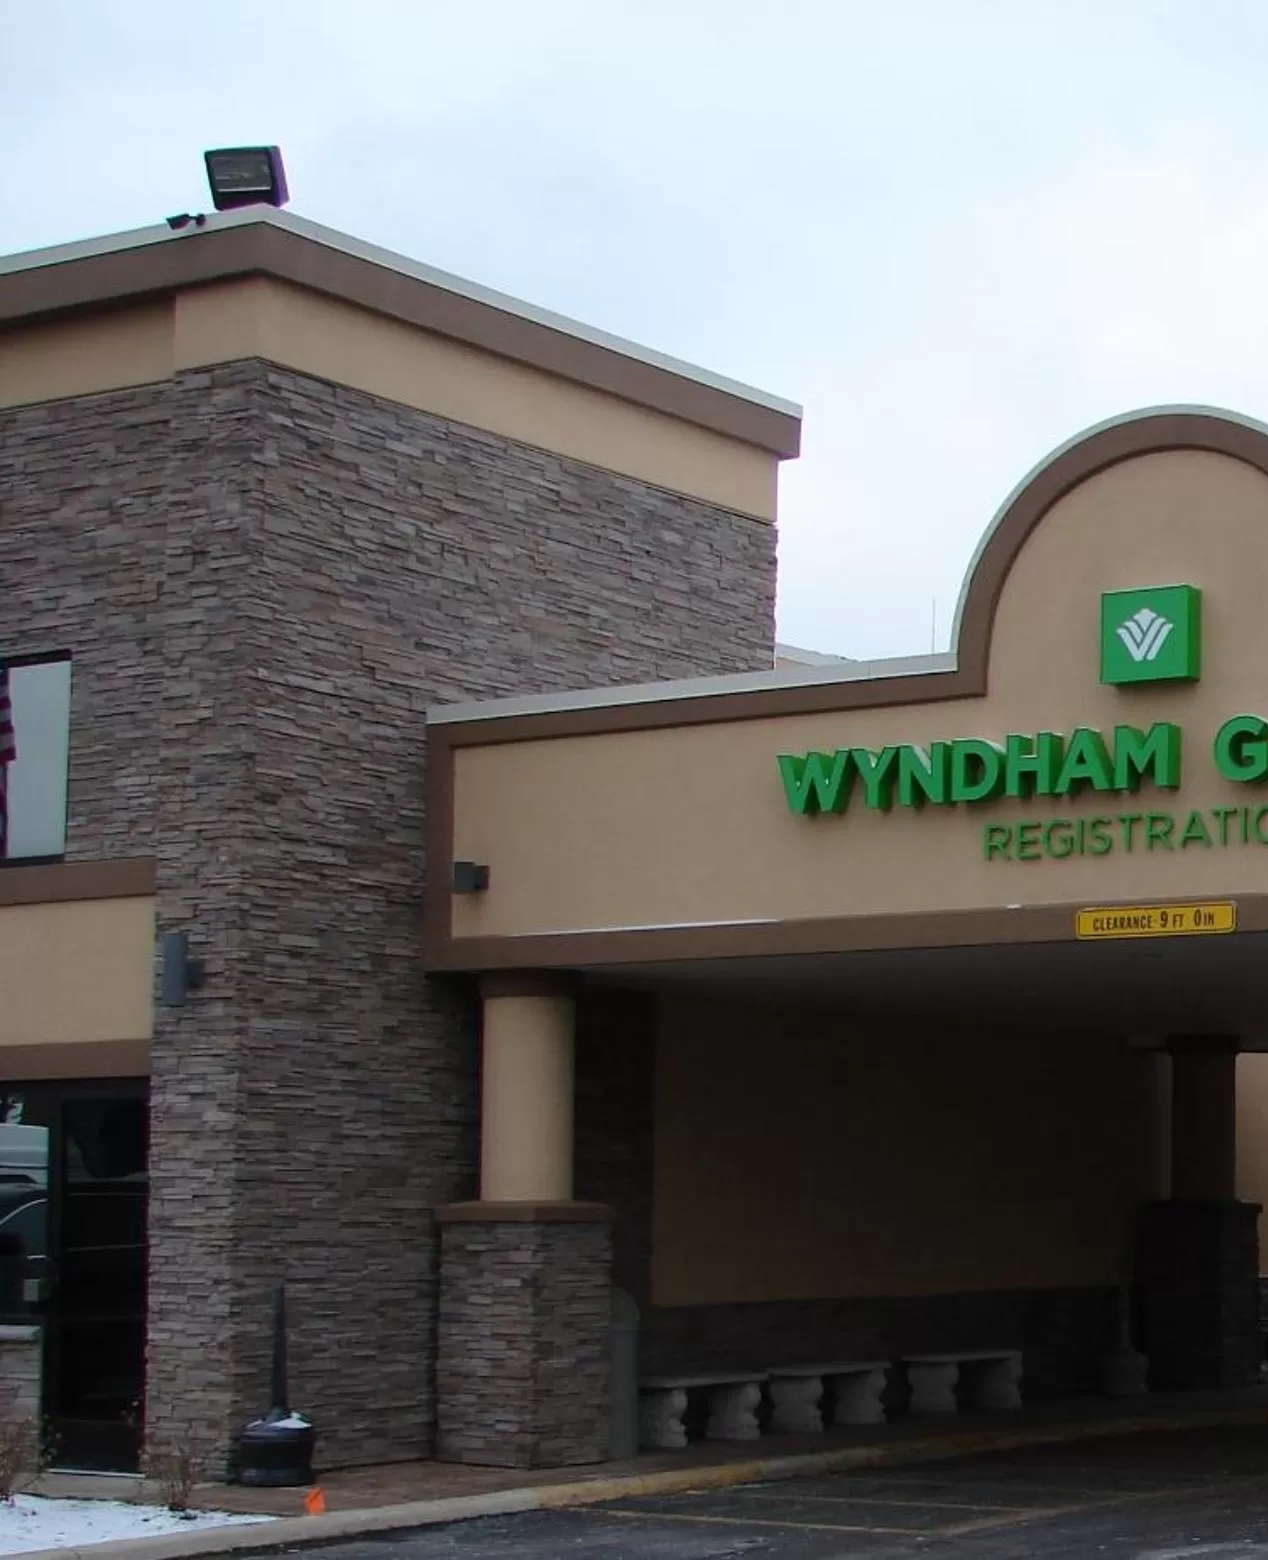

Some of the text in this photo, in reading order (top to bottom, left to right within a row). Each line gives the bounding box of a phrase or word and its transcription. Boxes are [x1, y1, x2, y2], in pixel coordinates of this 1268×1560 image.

[776, 722, 1182, 814] WYNDHAM
[1160, 910, 1169, 929] 9
[1172, 913, 1185, 928] FT
